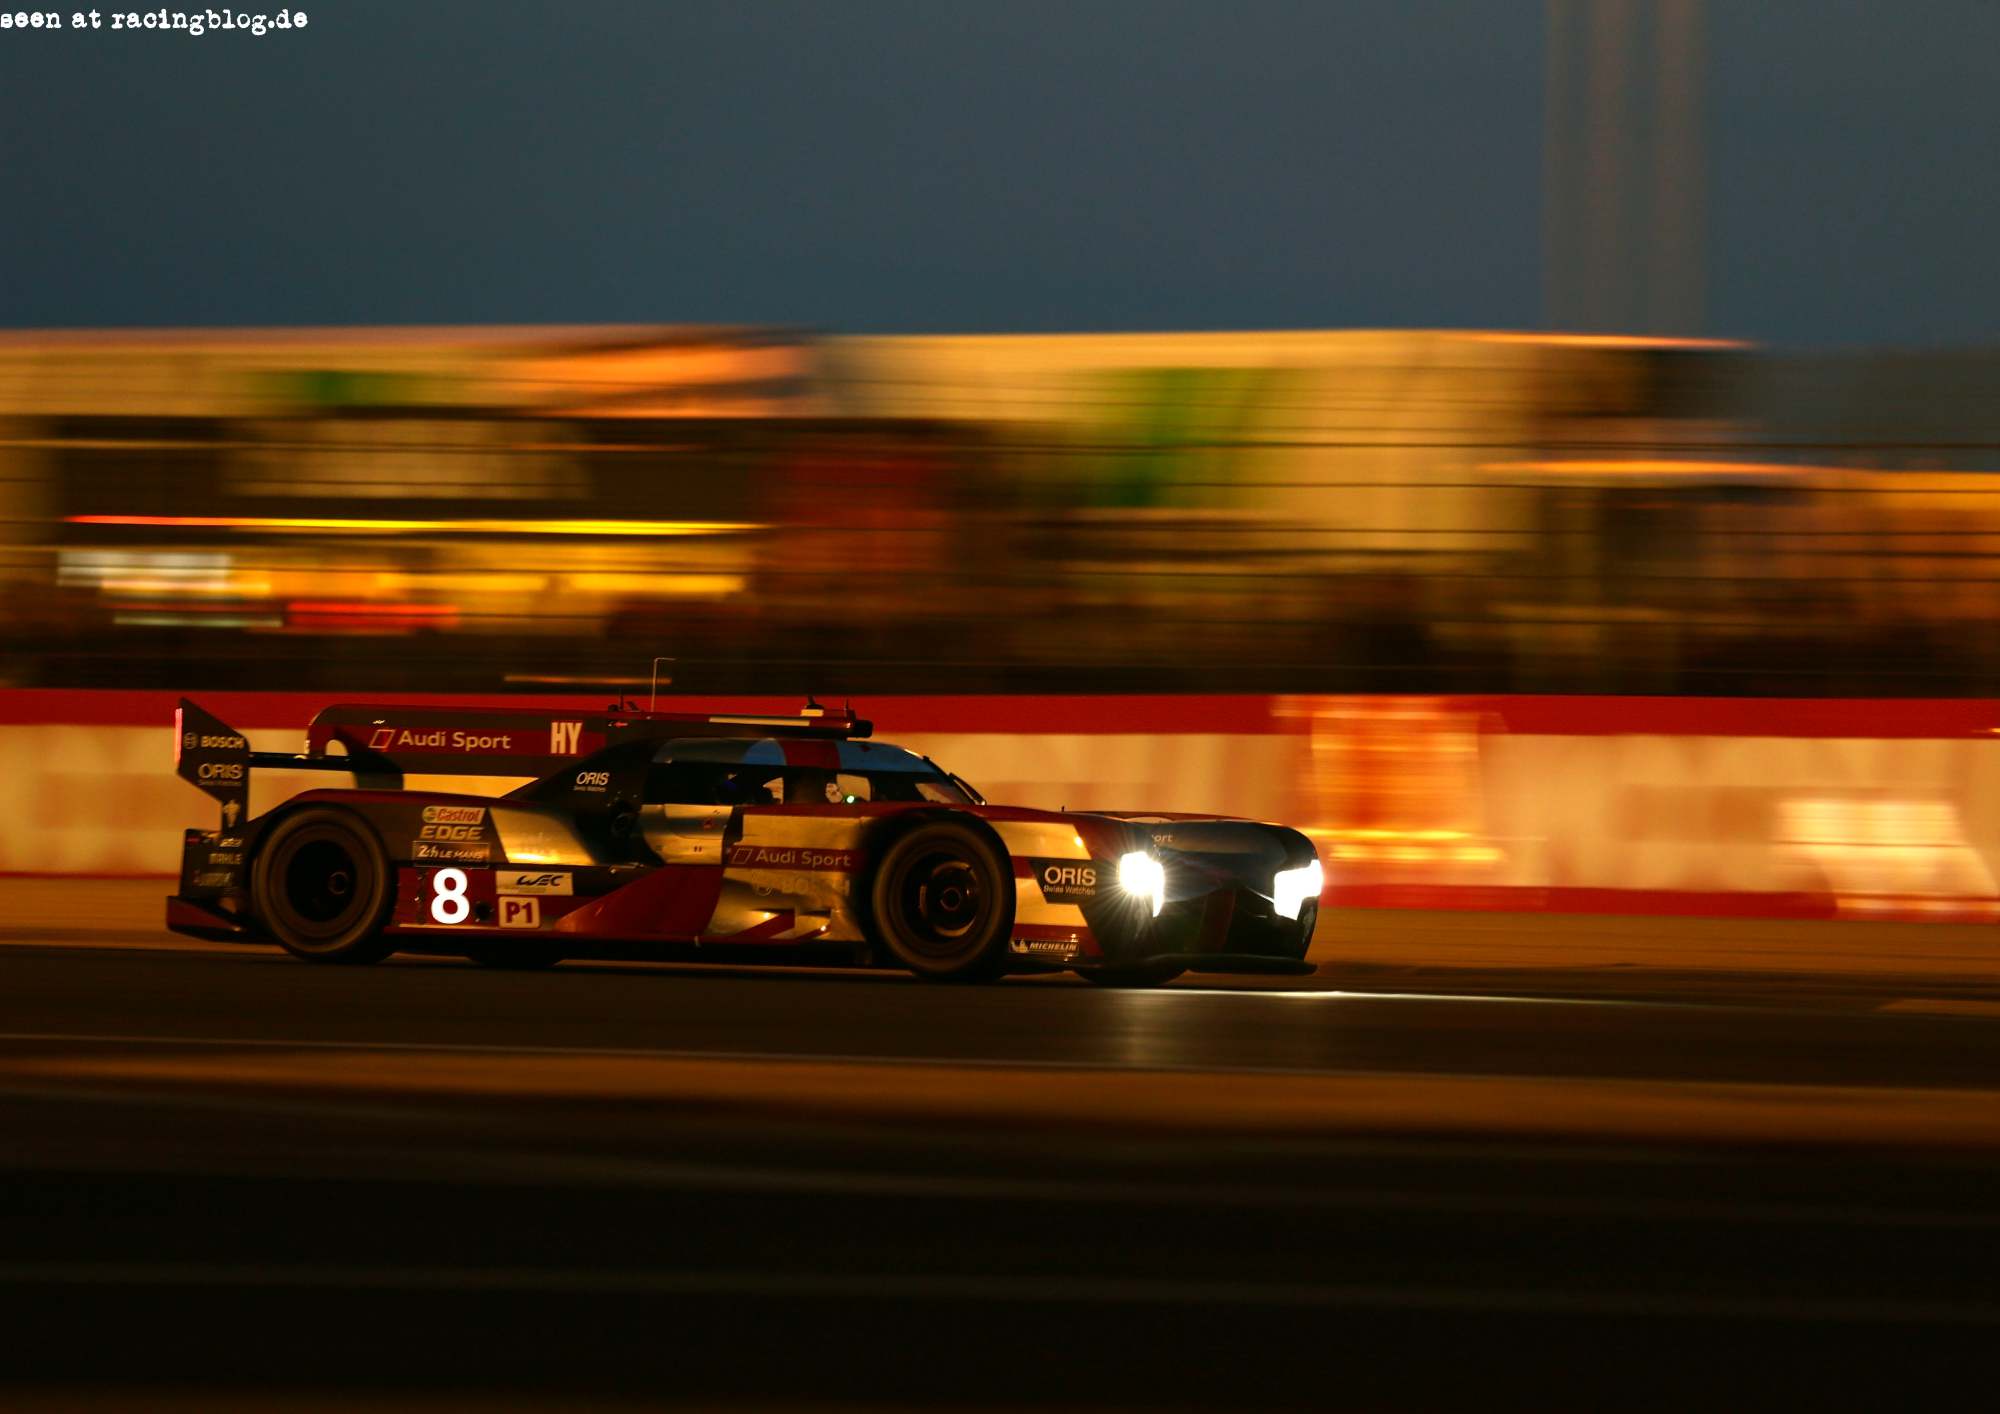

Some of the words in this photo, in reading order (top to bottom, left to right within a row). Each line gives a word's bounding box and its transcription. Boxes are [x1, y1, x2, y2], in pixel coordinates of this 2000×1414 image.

[200, 735, 243, 748] BOSCH
[398, 730, 446, 747] Audi
[452, 731, 511, 751] Sport
[550, 722, 582, 754] HY
[198, 763, 243, 778] ORIS
[576, 772, 610, 785] ORIS
[437, 809, 481, 822] Castrol
[420, 825, 484, 840] EDGE
[754, 849, 796, 864] Audi
[801, 851, 851, 868] Sport
[516, 875, 564, 886] WEC
[1044, 866, 1097, 886] ORIS
[430, 867, 470, 925] 8
[505, 901, 532, 924] P1
[1028, 941, 1078, 951] MICHELIN
